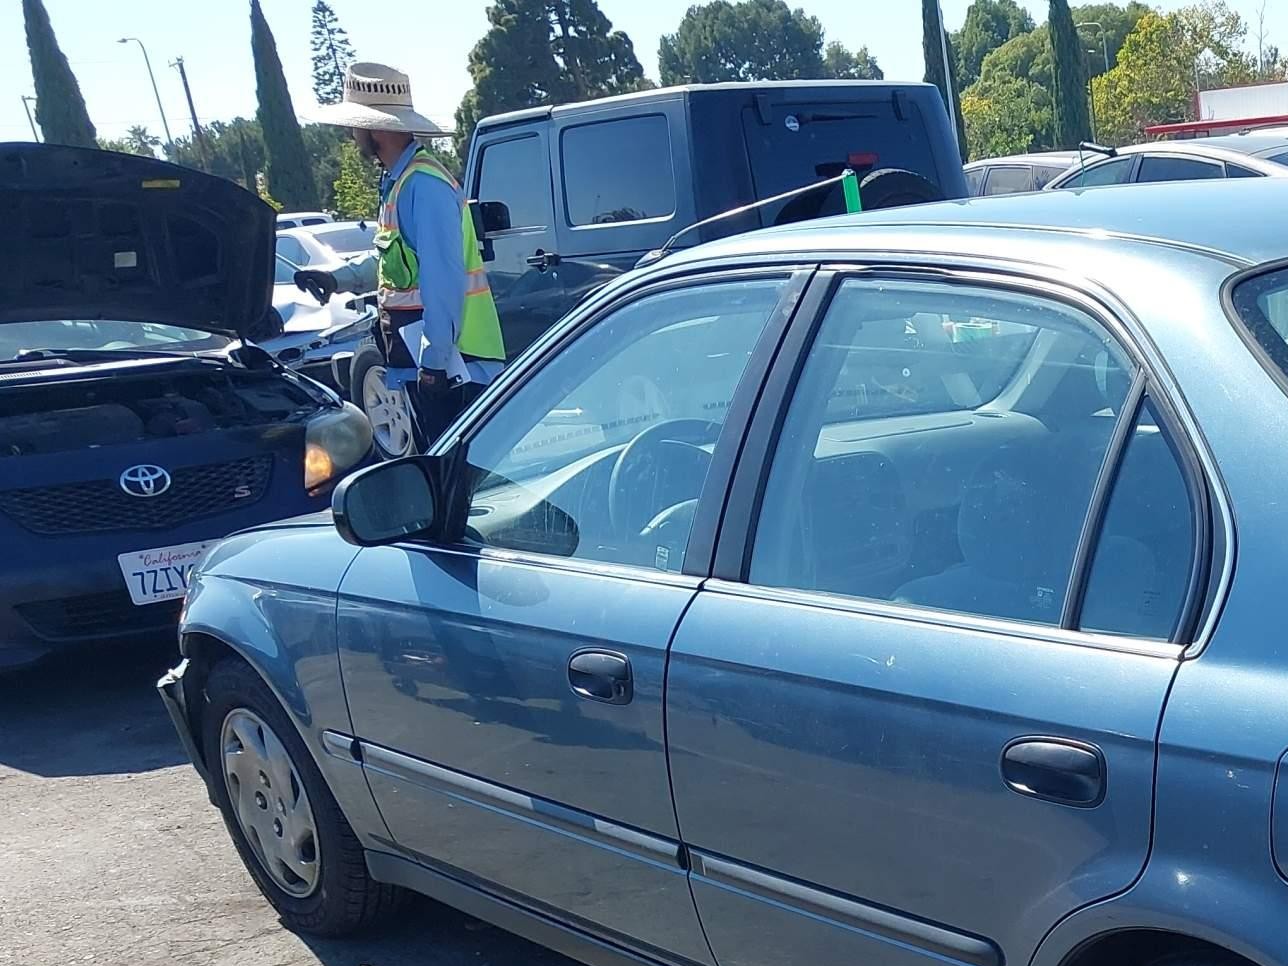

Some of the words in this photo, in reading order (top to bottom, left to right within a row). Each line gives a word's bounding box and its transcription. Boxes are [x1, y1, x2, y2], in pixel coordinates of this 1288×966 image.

[234, 485, 252, 498] S
[143, 550, 202, 567] California
[132, 564, 195, 596] 7ZIY
